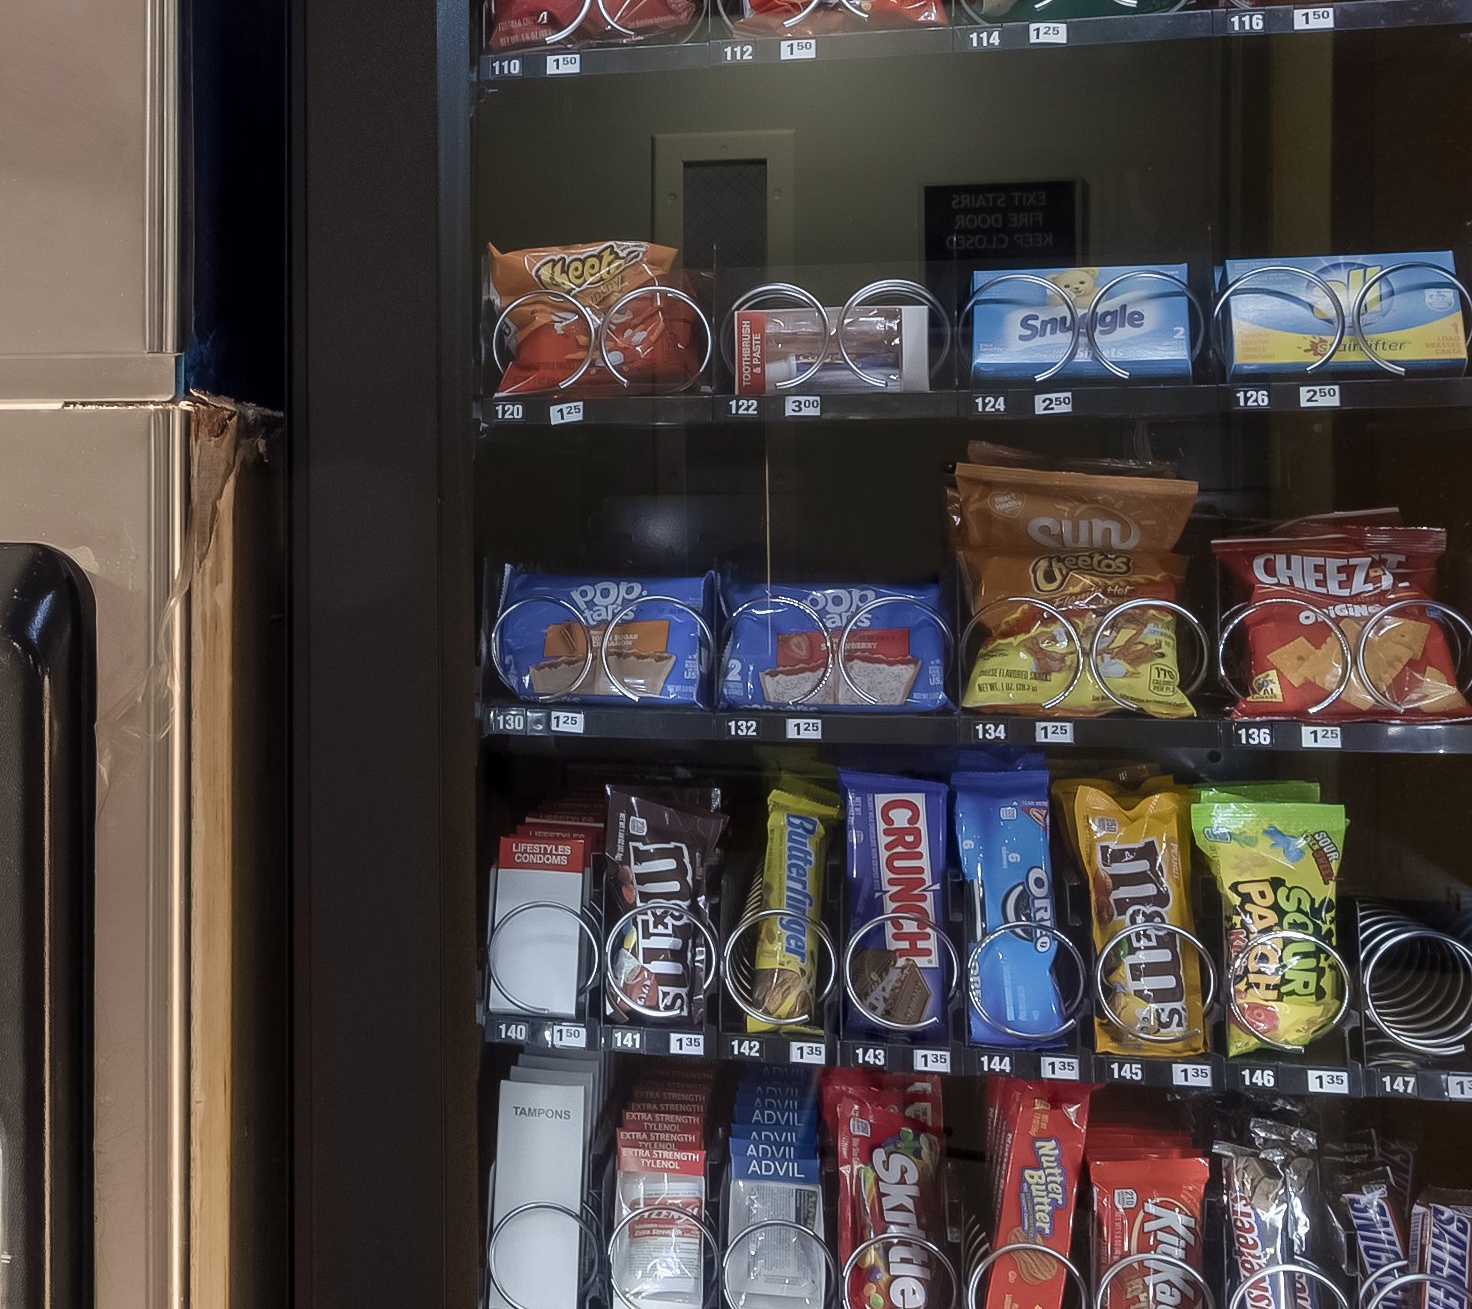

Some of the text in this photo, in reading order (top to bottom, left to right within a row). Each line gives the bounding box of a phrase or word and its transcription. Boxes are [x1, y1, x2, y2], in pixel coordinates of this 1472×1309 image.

[1230, 14, 1264, 31] 116
[969, 30, 1000, 48] 114
[723, 45, 752, 61] 112
[492, 59, 520, 76] 110
[742, 320, 751, 388] TOOTHBRUSH
[752, 333, 761, 367] PASTE
[729, 399, 757, 414] 122
[975, 396, 1005, 412] 124
[1236, 390, 1269, 407] 126
[495, 403, 523, 419] 120
[1032, 553, 1132, 592] Cheetos
[497, 715, 524, 730] 130
[728, 720, 757, 736] 132
[975, 723, 1005, 739] 134
[1237, 728, 1270, 745] 136
[512, 843, 572, 856] LIFESTYLES
[514, 853, 568, 866] CONDOMS
[784, 812, 819, 964] Butterfinger
[877, 797, 934, 963] CRUNCH
[1277, 884, 1318, 996] SOUR
[499, 1025, 526, 1040] 140
[614, 1032, 641, 1047] 141
[731, 1040, 760, 1056] 142
[856, 1049, 885, 1065] 143
[980, 1056, 1011, 1073] 144
[1110, 1063, 1142, 1080] 145
[1241, 1069, 1274, 1087] 146
[1382, 1075, 1415, 1093] 147
[512, 1106, 572, 1121] TAMPONS
[751, 1109, 804, 1126] ADVIL
[623, 1149, 700, 1162] EXTRA STRENGTH
[640, 1158, 680, 1170] TYLENOL
[747, 1160, 805, 1178] ADVIL
[1035, 1139, 1064, 1207] Nutter
[1023, 1168, 1051, 1236] Butter
